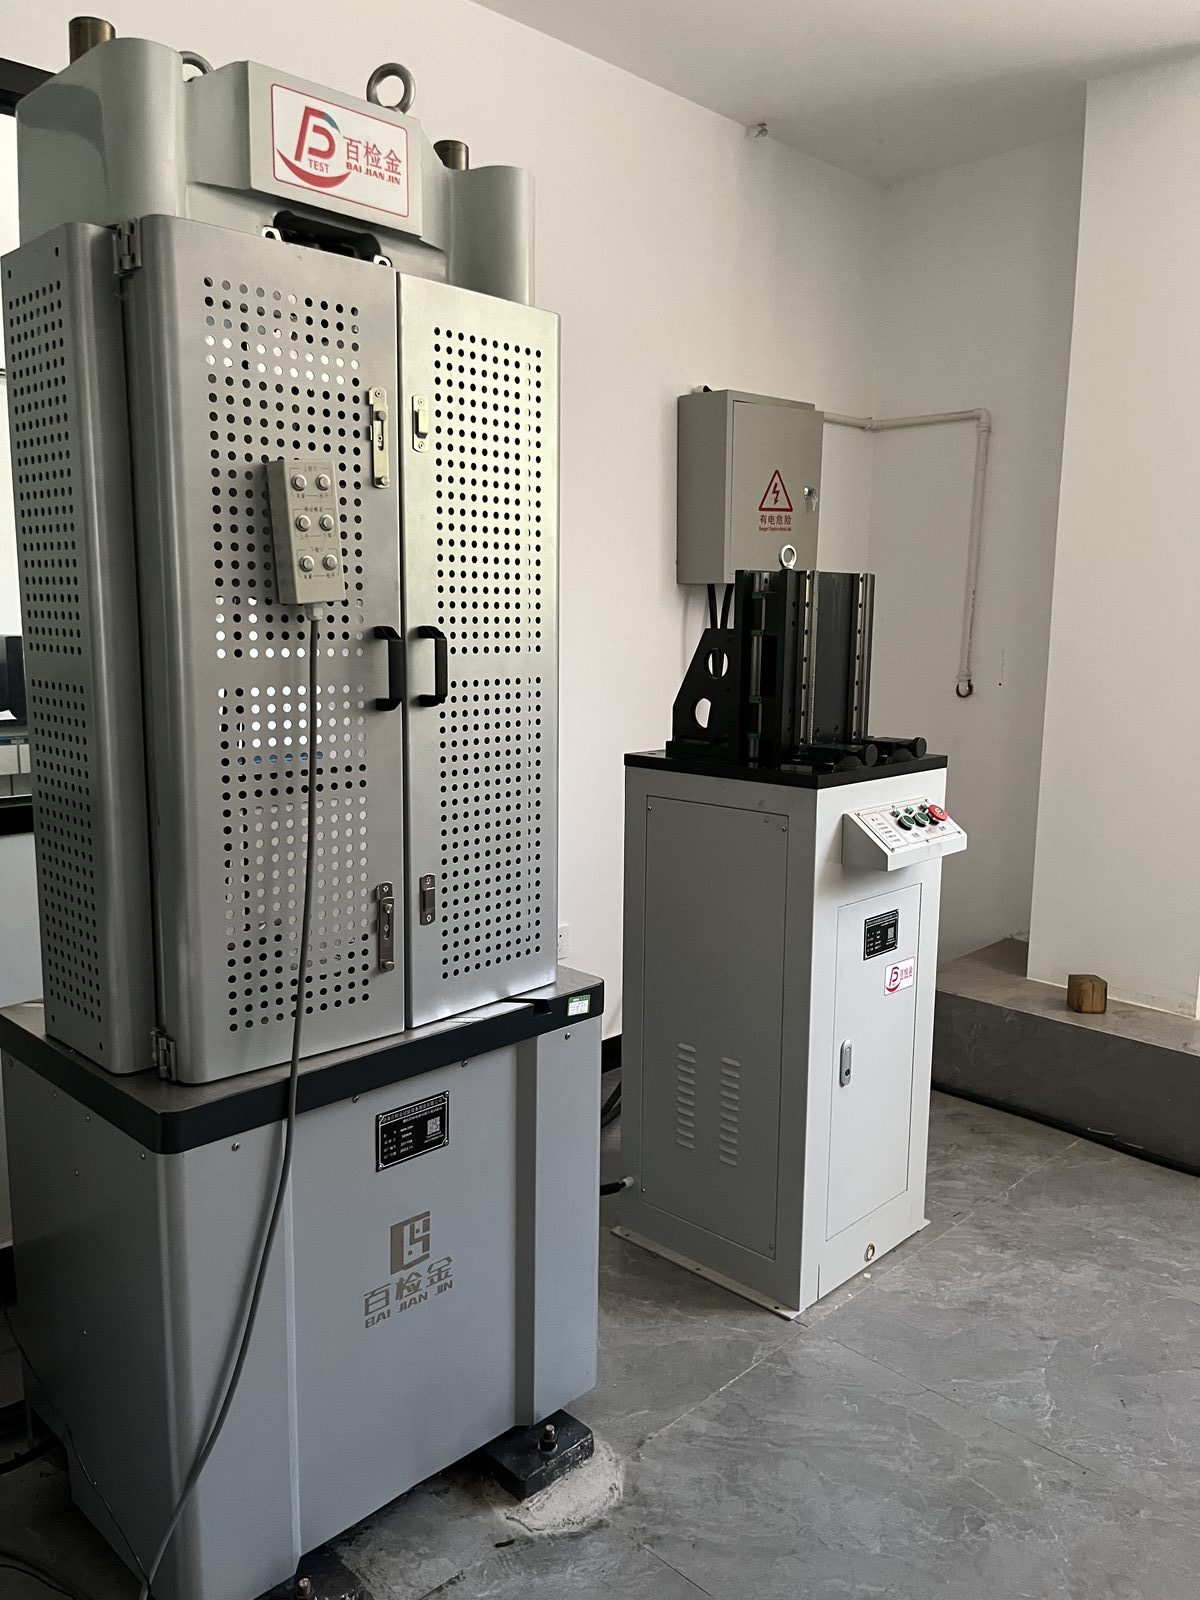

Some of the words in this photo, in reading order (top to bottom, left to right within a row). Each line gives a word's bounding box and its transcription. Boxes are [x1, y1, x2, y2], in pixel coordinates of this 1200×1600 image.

[308, 159, 329, 174] TEST
[343, 136, 402, 176] 百检金
[346, 161, 362, 173] BAI
[364, 169, 385, 181] JIAN
[388, 176, 401, 185] JIN
[760, 514, 792, 525] 有电危险
[364, 1256, 453, 1316] 百检金
[365, 1309, 391, 1329] BAI
[397, 1291, 428, 1314] JIAN
[434, 1280, 453, 1296] JIN
